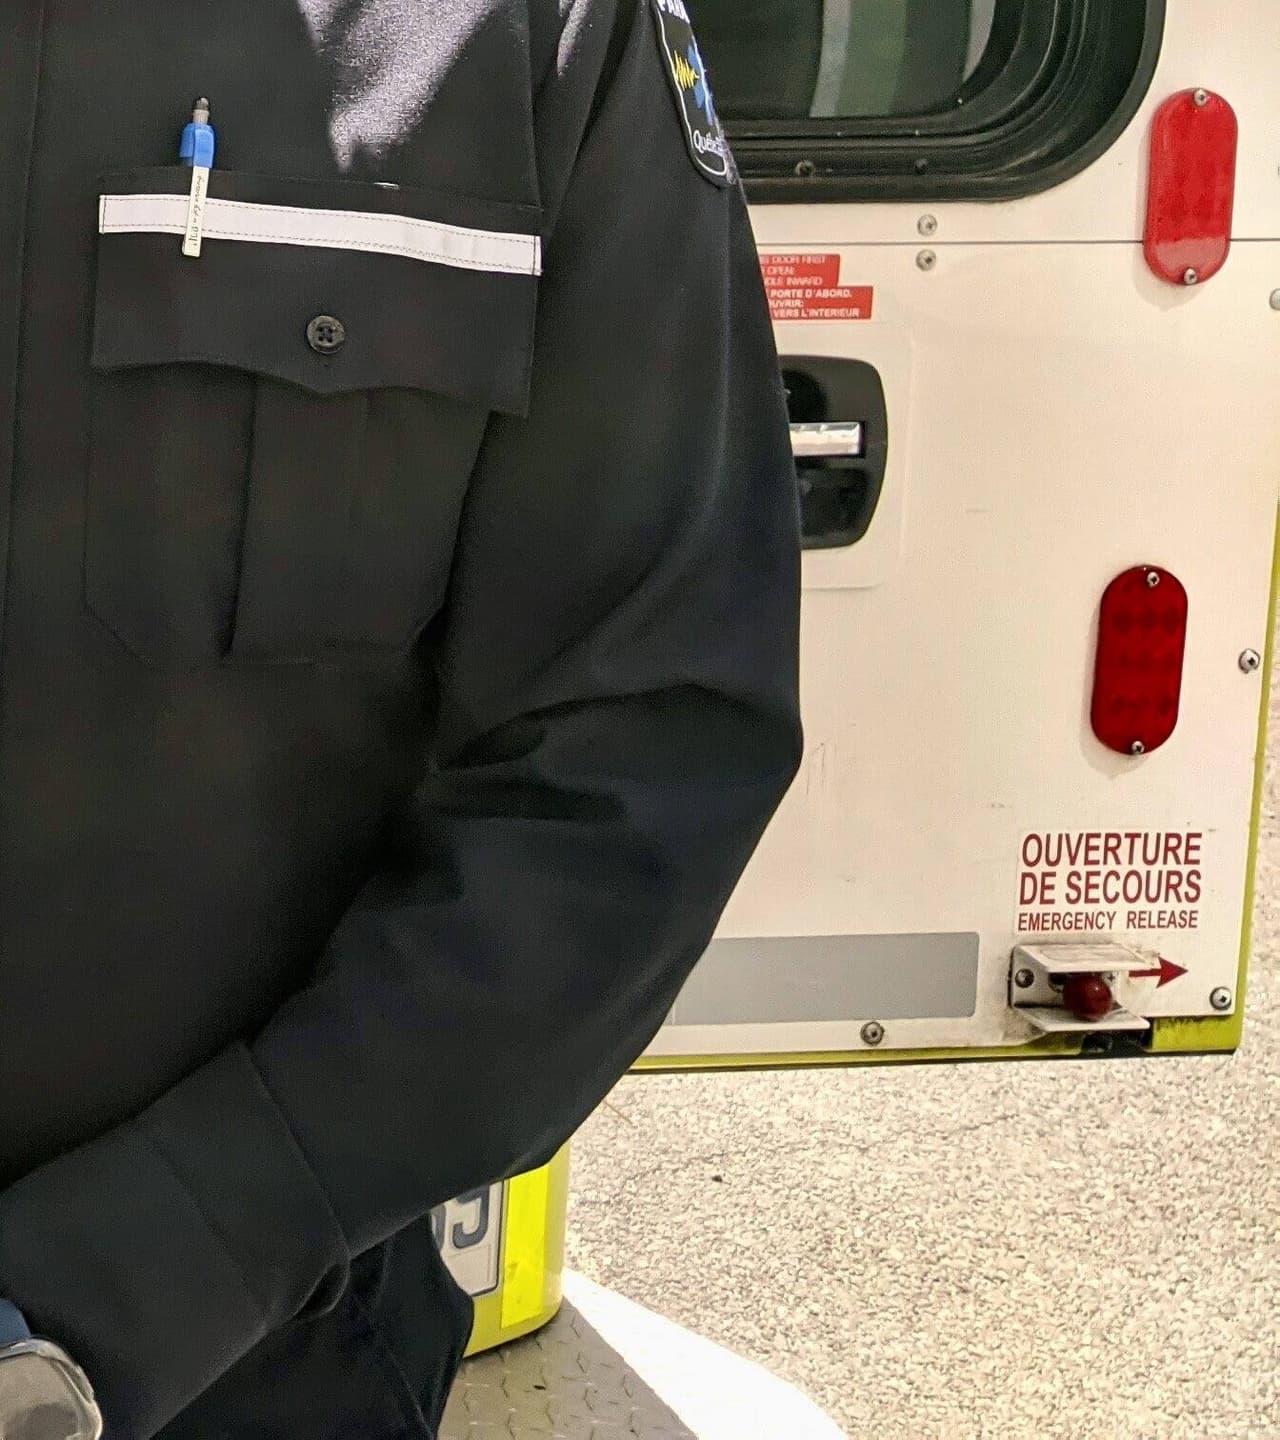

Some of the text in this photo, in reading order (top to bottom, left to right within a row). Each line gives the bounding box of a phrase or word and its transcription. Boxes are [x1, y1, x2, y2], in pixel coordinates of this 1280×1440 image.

[770, 288, 802, 298] PORTE
[773, 308, 799, 318] VERS
[1021, 831, 1202, 867] OUVERTURE
[1019, 869, 1202, 905] DE SECOURS
[1017, 909, 1199, 931] EMERGENCY RELEASE
